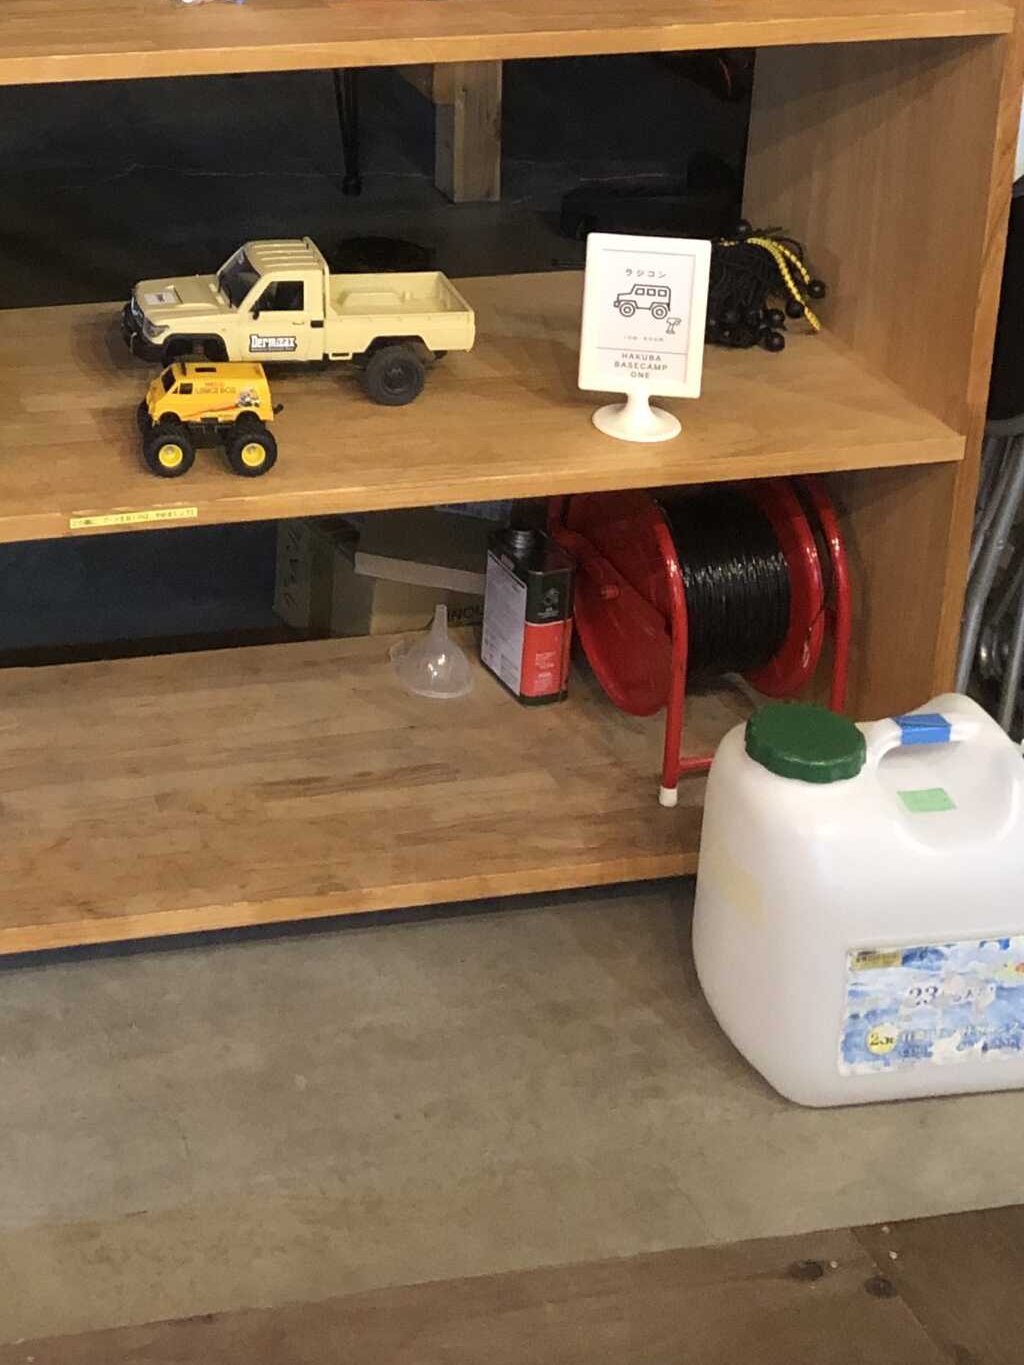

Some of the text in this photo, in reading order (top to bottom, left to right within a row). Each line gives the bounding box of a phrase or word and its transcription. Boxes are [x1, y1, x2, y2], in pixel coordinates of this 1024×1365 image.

[625, 267, 667, 279] ラジコン
[621, 352, 662, 362] HAKUBA
[614, 361, 668, 371] BASECAMP
[630, 371, 650, 379] ONE
